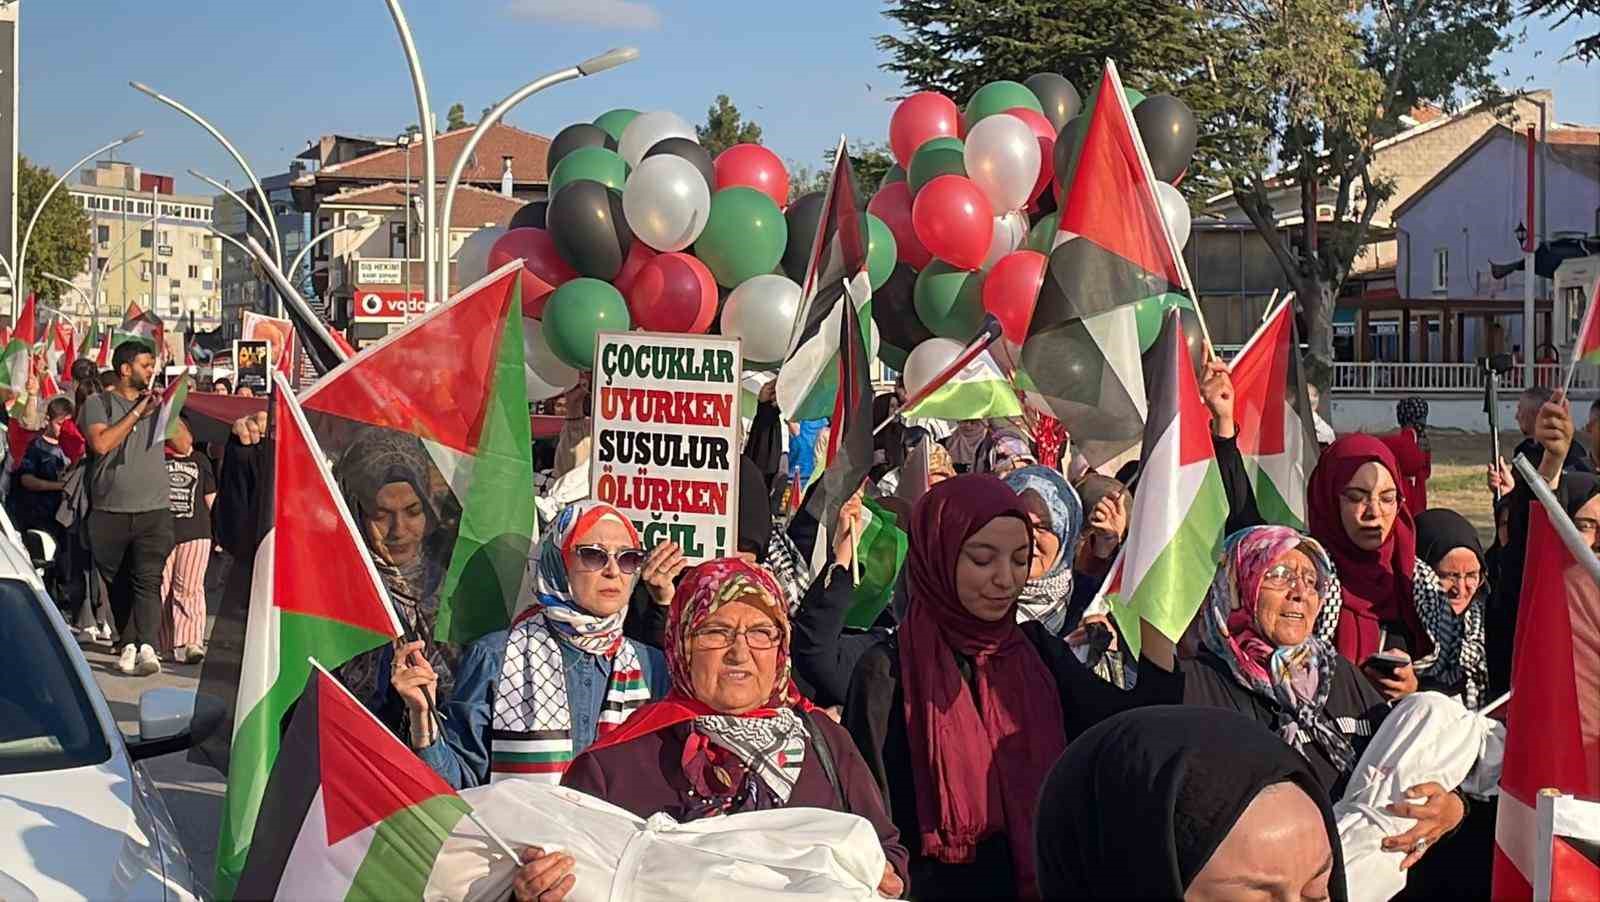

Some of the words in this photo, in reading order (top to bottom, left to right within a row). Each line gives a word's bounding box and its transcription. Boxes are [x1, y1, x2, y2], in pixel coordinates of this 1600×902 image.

[602, 343, 734, 385] ÇOCUKLAR
[601, 387, 733, 427] UYURKEN
[599, 429, 730, 470] SUSULUR
[597, 464, 728, 515] ÖLÜRKEN
[632, 512, 704, 557] ĞİL
